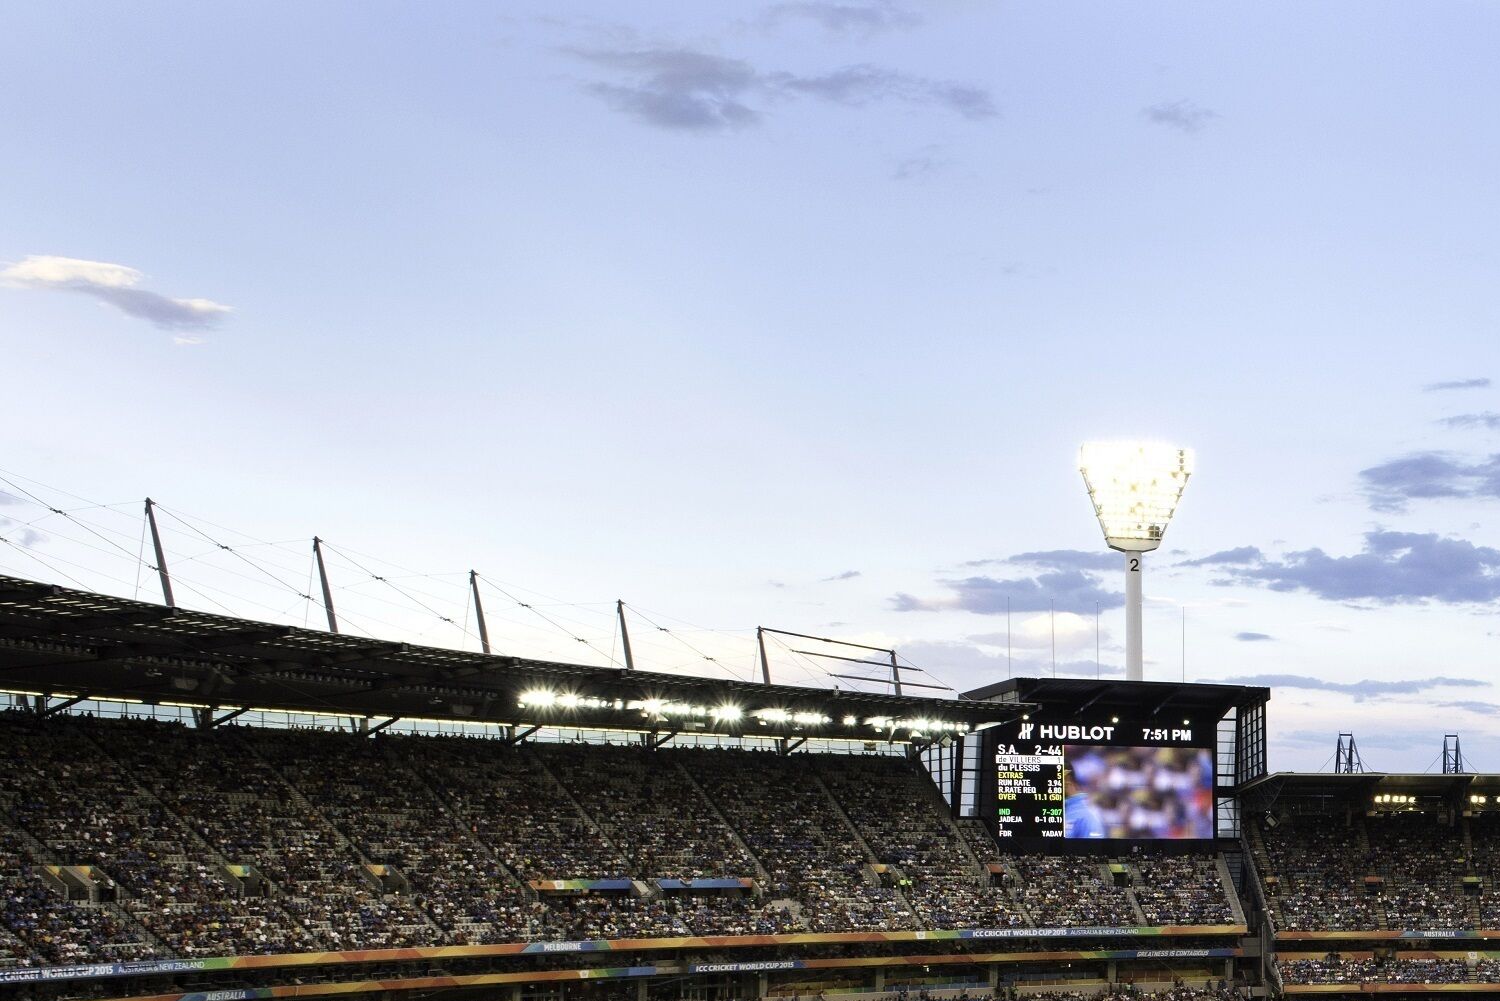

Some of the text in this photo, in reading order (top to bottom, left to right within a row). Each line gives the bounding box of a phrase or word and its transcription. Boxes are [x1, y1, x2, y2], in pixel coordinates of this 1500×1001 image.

[1130, 558, 1139, 572] 2
[1040, 724, 1114, 740] HUBLOT
[1142, 728, 1192, 741] 7:51 PM
[998, 744, 1061, 755] S.A. 2-44
